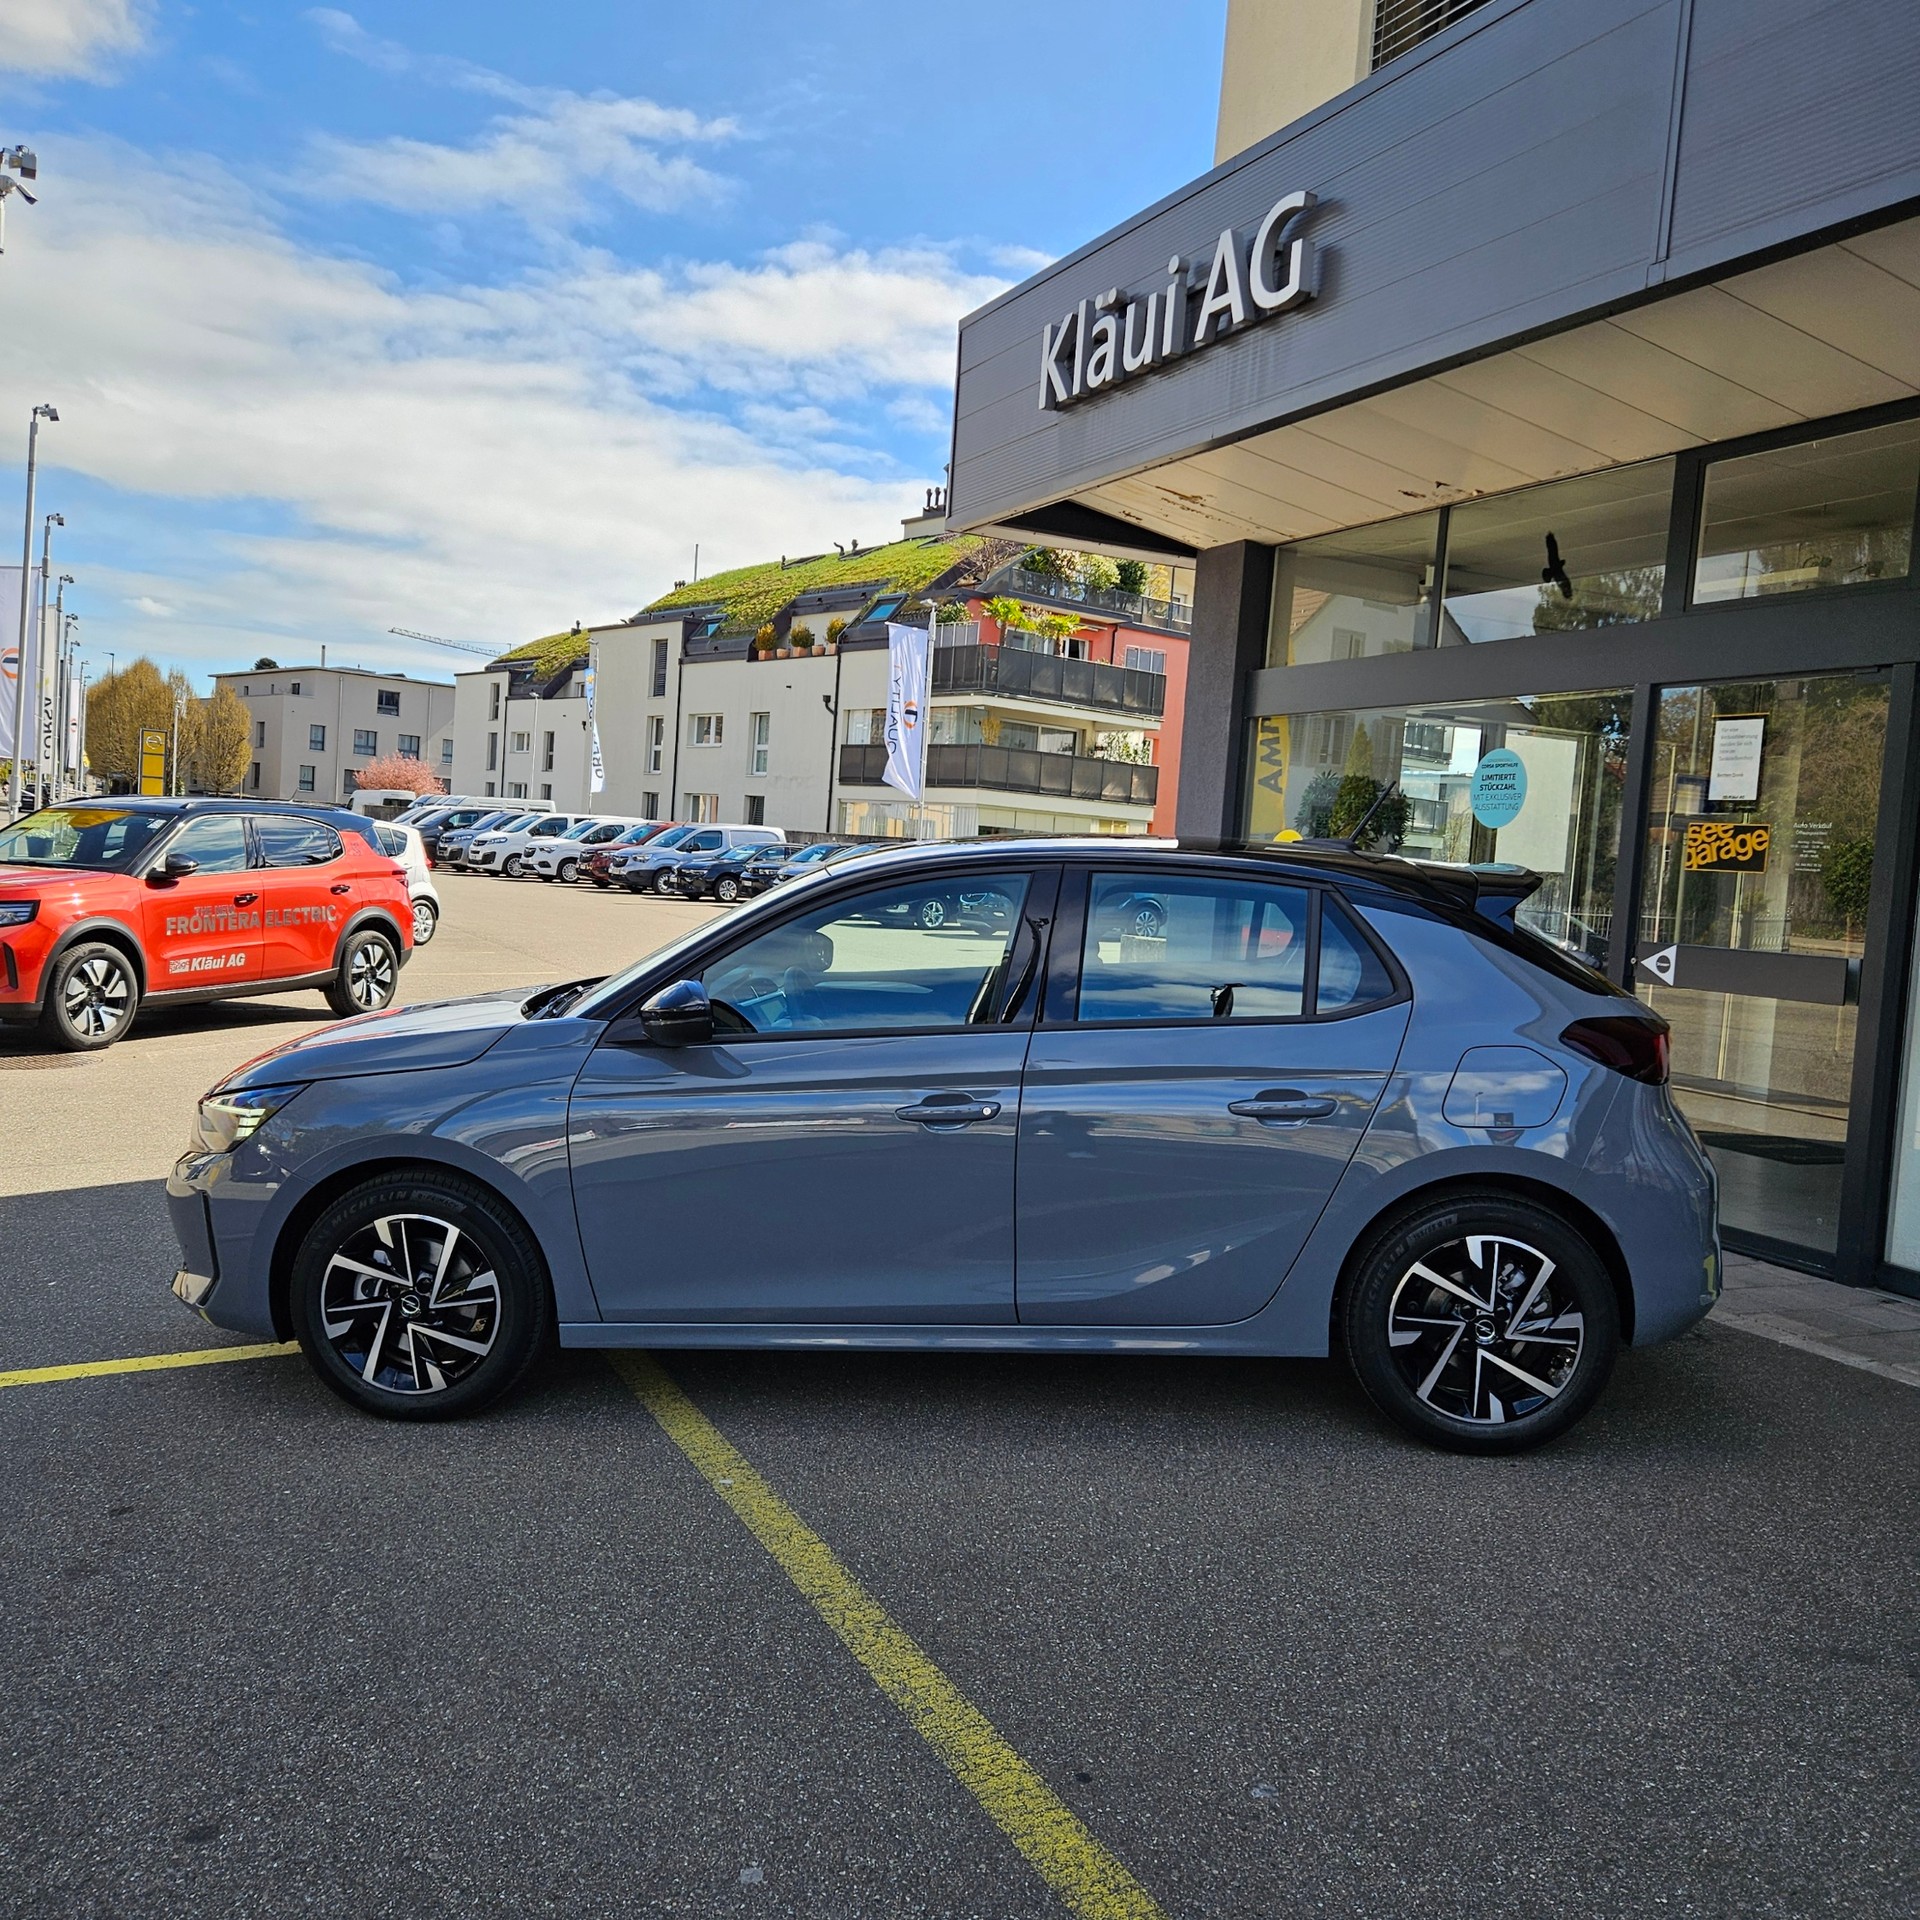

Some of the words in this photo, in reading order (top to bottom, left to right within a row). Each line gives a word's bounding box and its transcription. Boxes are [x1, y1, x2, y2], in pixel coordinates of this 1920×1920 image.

[1038, 254, 1187, 410] Kläui
[1194, 190, 1314, 344] AG
[1479, 782, 1517, 791] STÜCKZAHL
[1481, 773, 1517, 782] LIMITIERTE
[1473, 793, 1484, 801] MIT
[1485, 792, 1522, 801] EXKLUSIVER
[1474, 802, 1519, 811] AUSSTATTUNG
[1687, 823, 1735, 846] see
[1684, 829, 1769, 869] garage
[166, 911, 262, 936] FRONTERA
[265, 905, 337, 927] ELECTRIC
[191, 955, 226, 972] Kläui
[227, 952, 246, 967] AG
